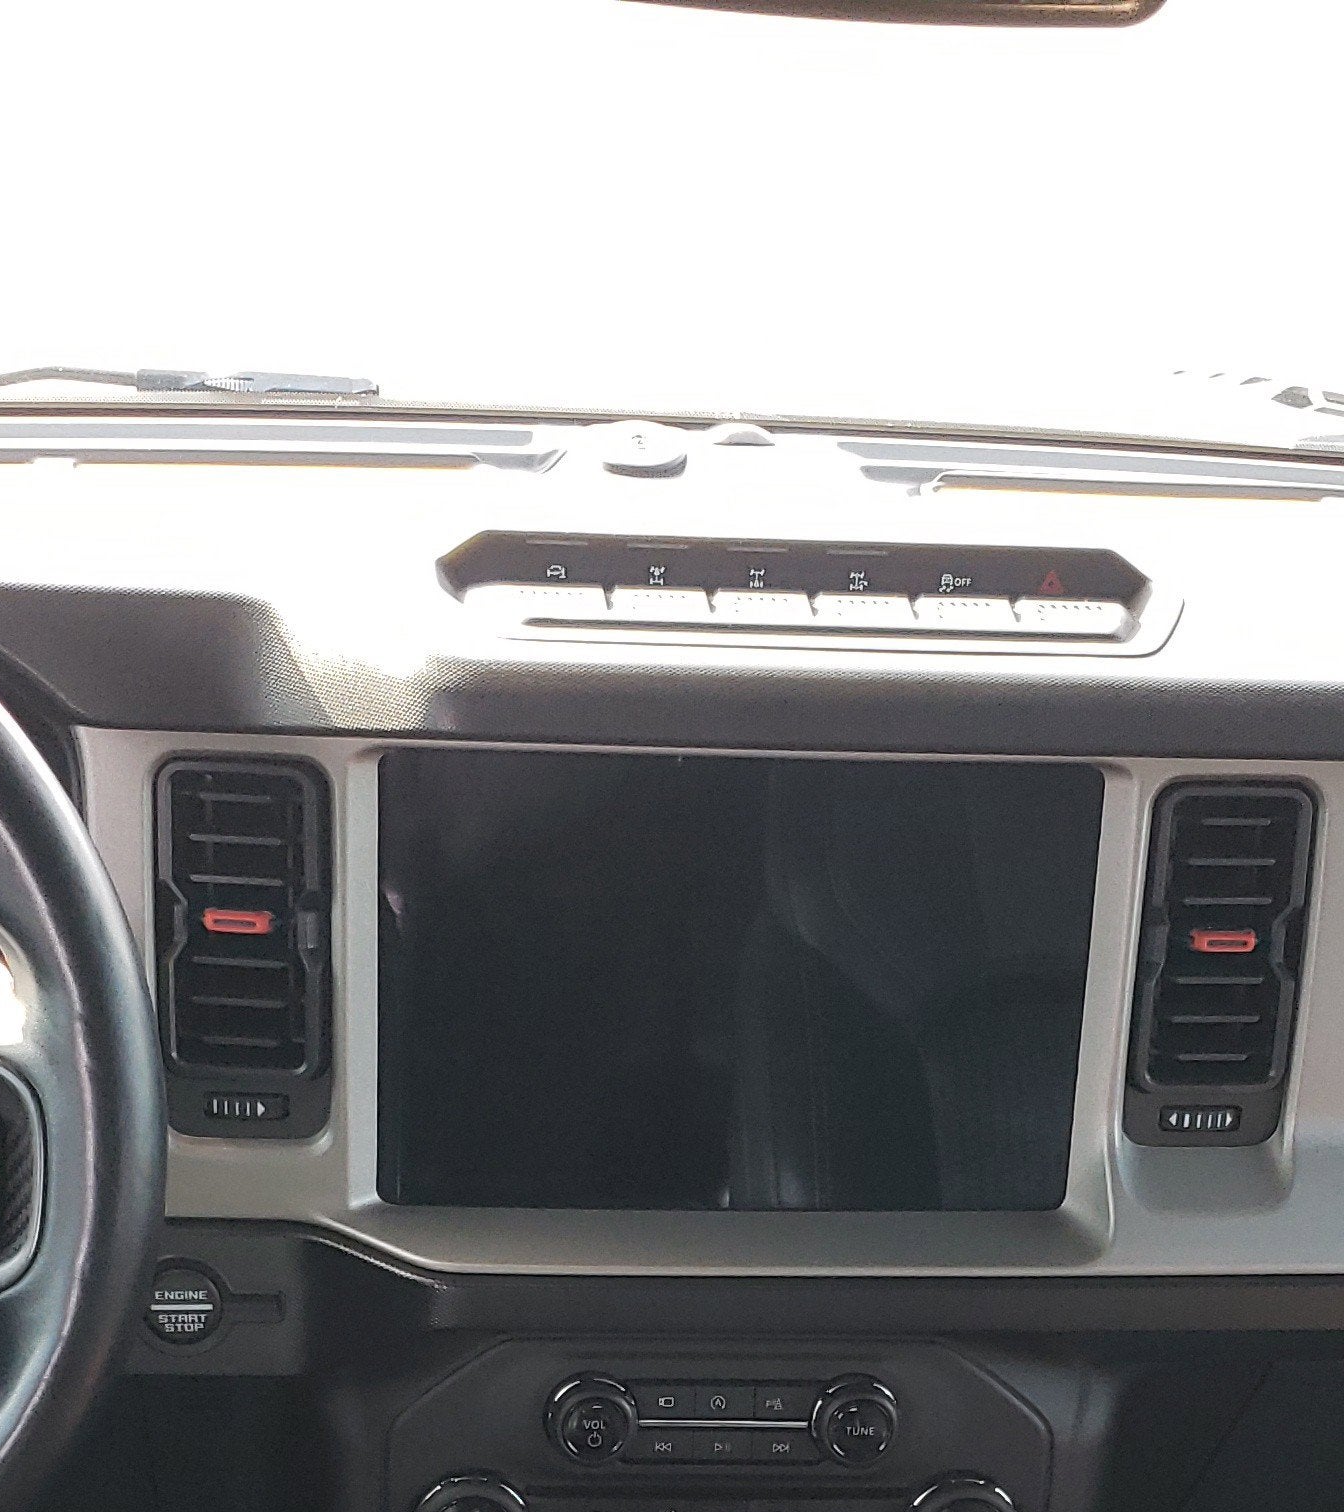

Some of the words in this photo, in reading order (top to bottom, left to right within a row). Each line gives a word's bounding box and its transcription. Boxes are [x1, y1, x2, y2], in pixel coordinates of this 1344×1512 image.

[954, 577, 972, 587] OFF
[155, 1290, 209, 1300] ENGINE
[158, 1313, 208, 1323] START
[164, 1323, 205, 1333] STOP
[583, 1419, 606, 1430] VOL
[846, 1426, 875, 1436] TUNE
